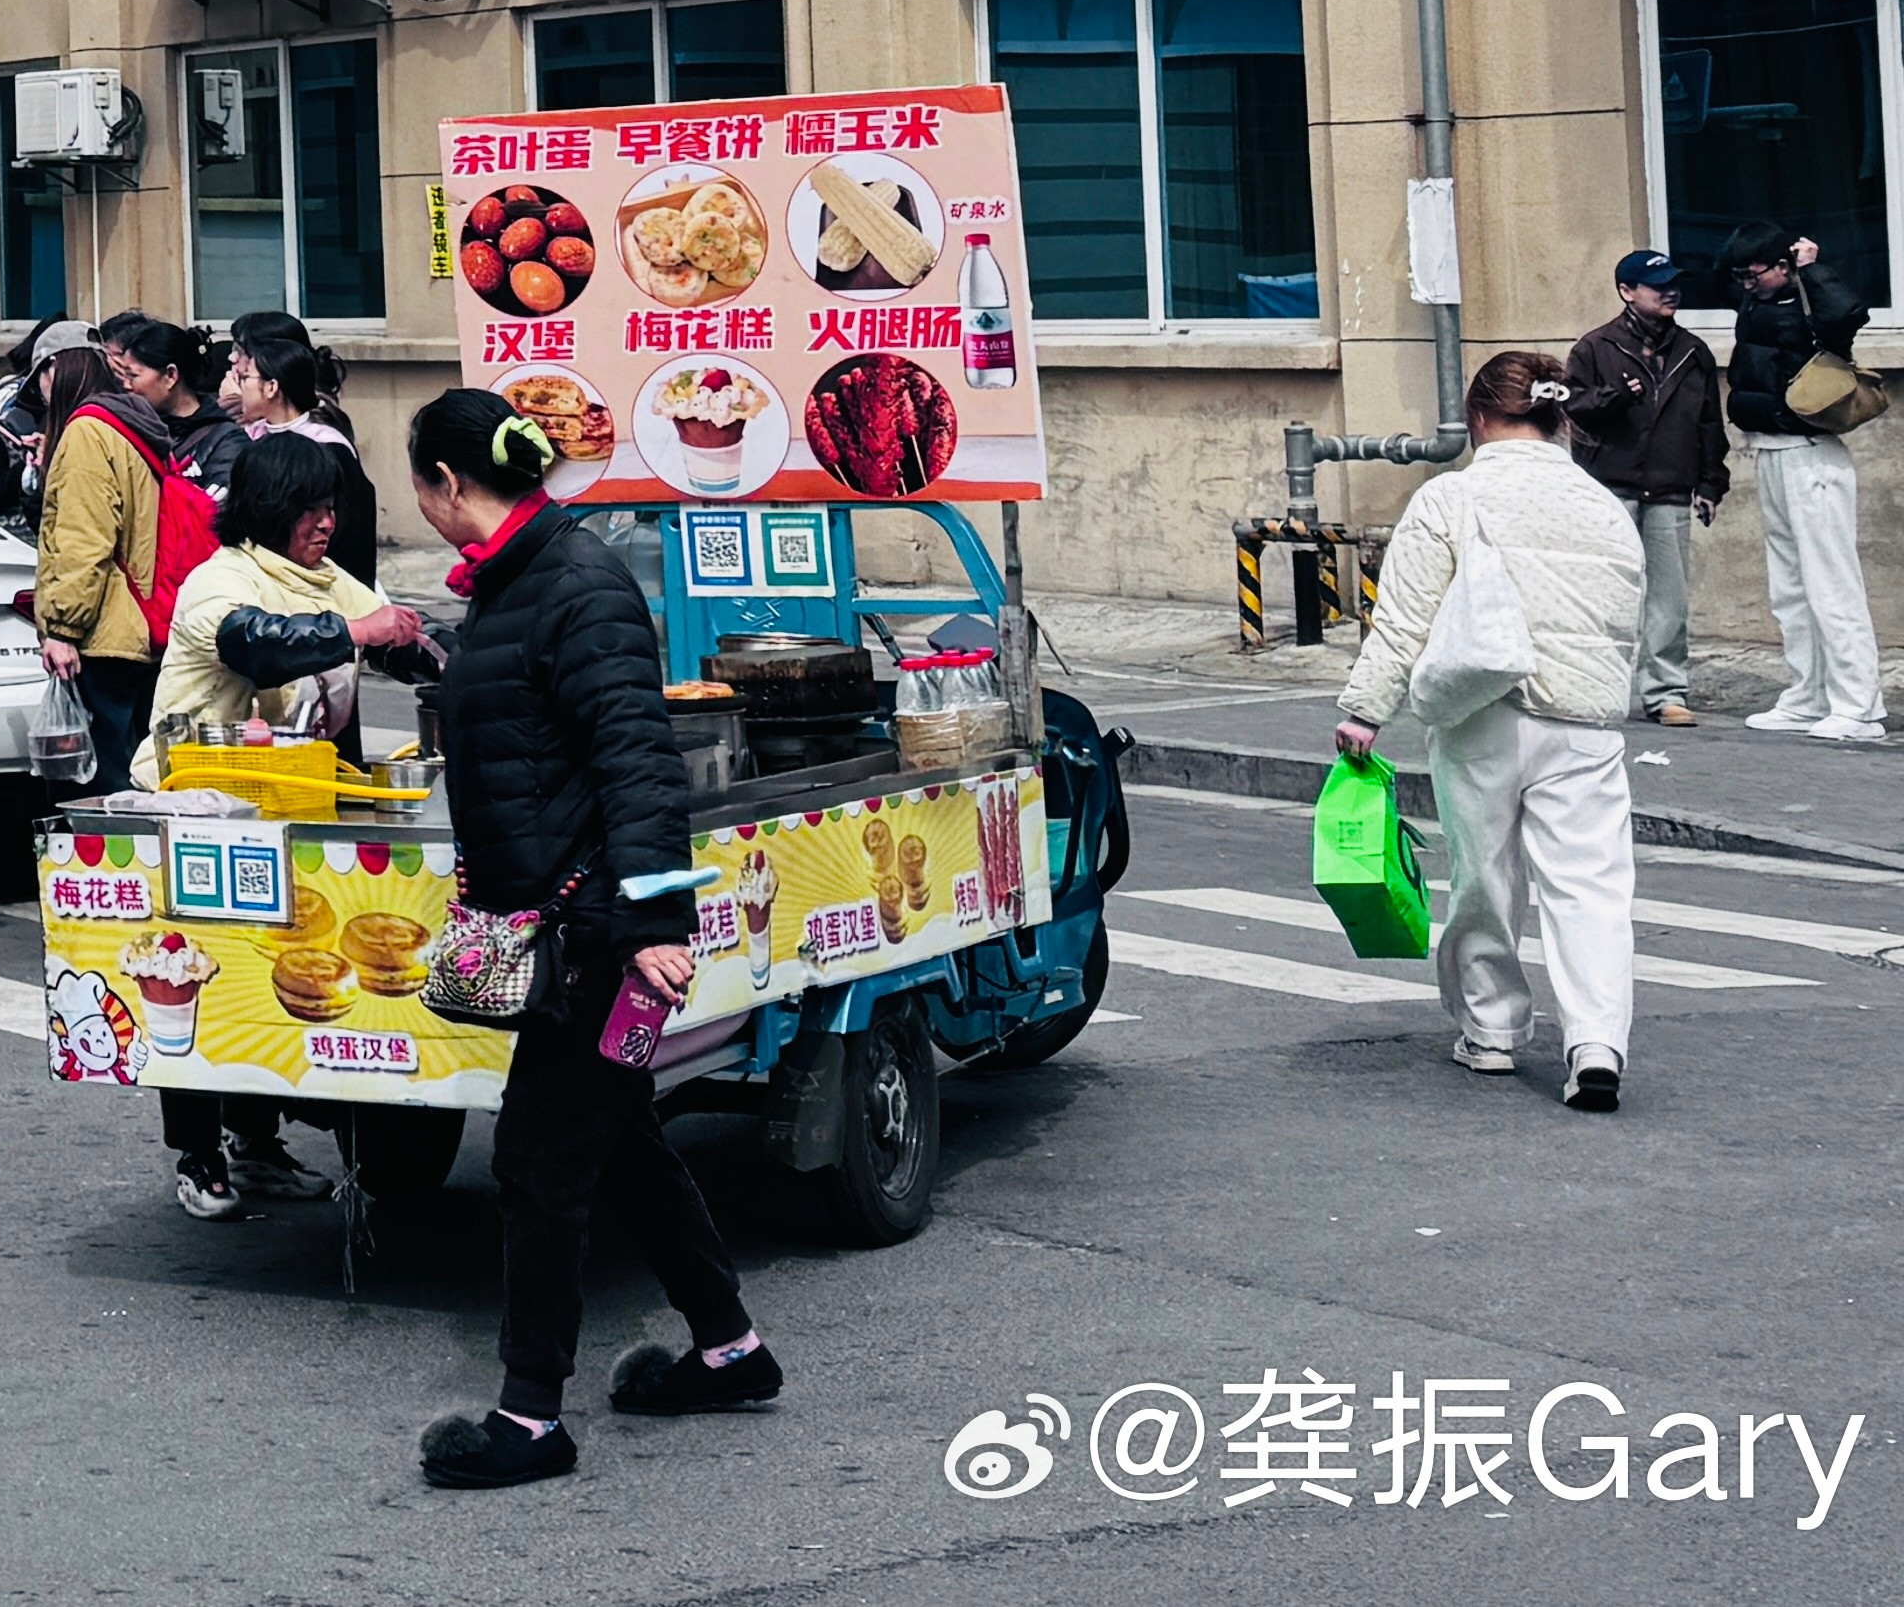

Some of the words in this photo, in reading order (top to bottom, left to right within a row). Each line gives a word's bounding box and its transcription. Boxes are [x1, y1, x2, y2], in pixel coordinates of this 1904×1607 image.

[452, 128, 592, 175] 茶叶蛋
[617, 116, 765, 165] 早餐饼
[785, 105, 941, 155] 糯玉米
[950, 200, 1006, 219] 矿泉水
[482, 319, 576, 364] 汉堡
[625, 307, 774, 351] 梅花糕
[807, 305, 963, 350] 火腿肠
[53, 876, 145, 911] 梅花糕
[692, 898, 735, 945] 花糕
[806, 905, 876, 952] 鸡蛋汉堡
[310, 1034, 410, 1063] 鸡蛋汉堡
